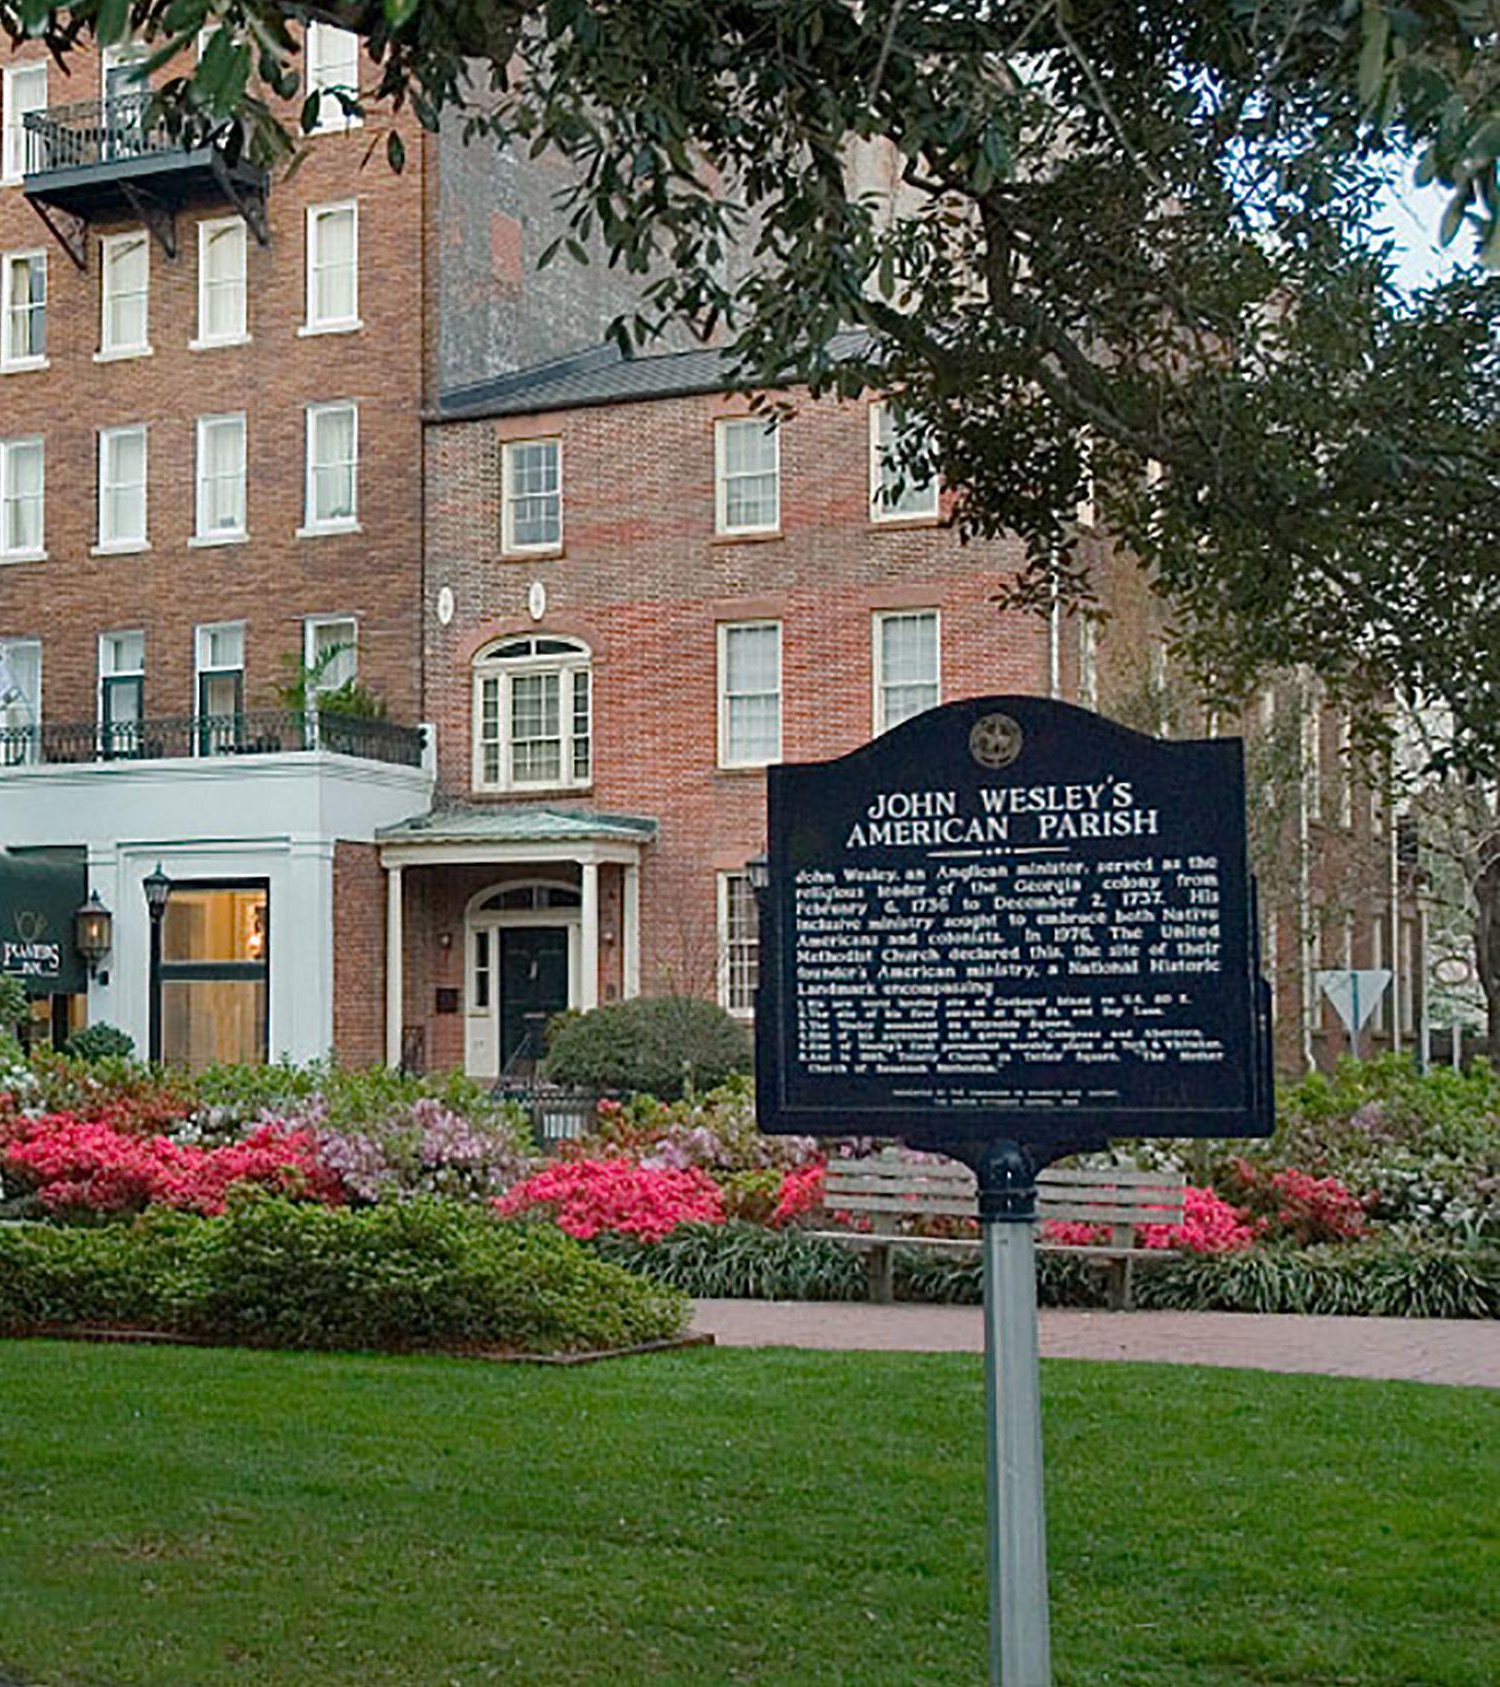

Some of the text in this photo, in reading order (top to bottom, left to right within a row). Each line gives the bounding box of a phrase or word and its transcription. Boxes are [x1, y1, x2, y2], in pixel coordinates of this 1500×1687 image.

[867, 774, 1134, 819] JOHN WESLEY'S
[846, 808, 1159, 848] AMERICAN PARISH
[936, 864, 1008, 883] Anglican
[1097, 857, 1153, 874] served
[1188, 855, 1218, 870] the
[937, 882, 956, 896] of
[971, 880, 998, 895] the
[1014, 877, 1081, 896] Georgia
[1102, 876, 1161, 891] colony
[1176, 873, 1219, 888] from
[962, 898, 981, 911] to
[993, 896, 1078, 911] December
[1189, 888, 1220, 904] His
[867, 915, 935, 932] ministry
[1008, 913, 1026, 926] to
[1114, 908, 1156, 923] both
[887, 931, 918, 946] and
[1024, 929, 1041, 943] In
[1108, 926, 1144, 941] The
[1160, 923, 1220, 939] United
[881, 947, 941, 963] Church
[948, 945, 1020, 961] declared
[1073, 943, 1103, 958] the
[1148, 941, 1167, 957] of
[877, 965, 956, 979] American
[1068, 959, 1140, 975] National
[1150, 957, 1221, 973] Historic
[797, 981, 877, 996] Landmark
